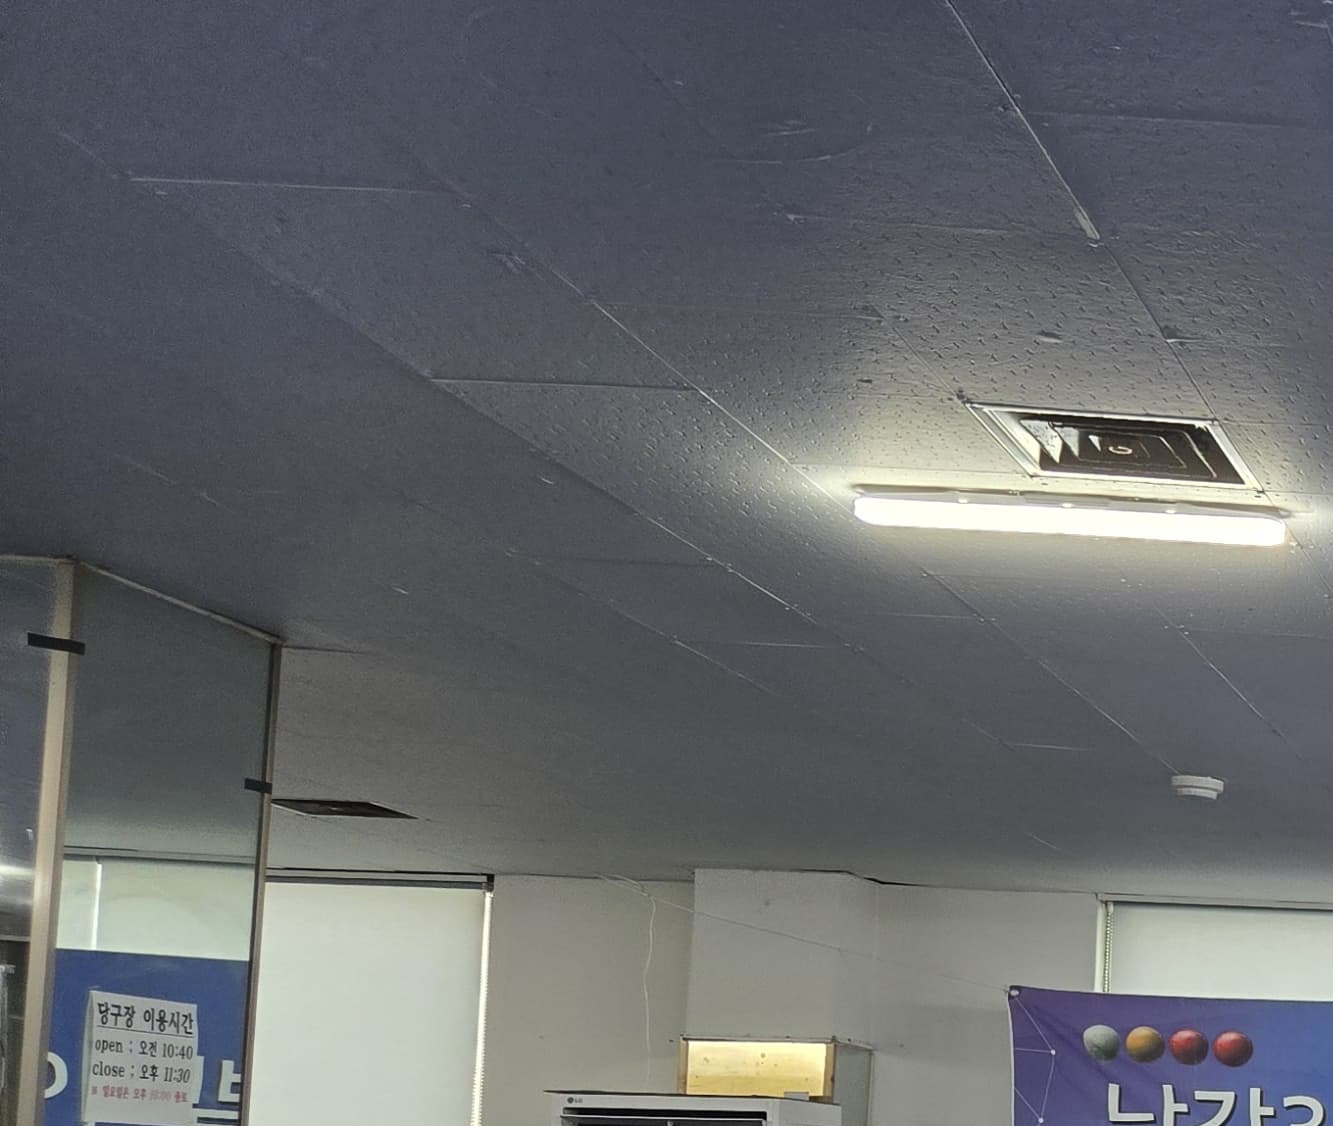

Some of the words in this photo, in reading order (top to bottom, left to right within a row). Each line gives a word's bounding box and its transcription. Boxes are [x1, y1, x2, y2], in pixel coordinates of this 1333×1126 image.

[97, 1002, 136, 1028] 당구장
[143, 1008, 194, 1035] 이용시간
[95, 1040, 123, 1053] open
[162, 1043, 194, 1060] 10:40
[92, 1061, 125, 1077] close
[139, 1064, 159, 1082] 오후
[164, 1066, 191, 1083] 11:30
